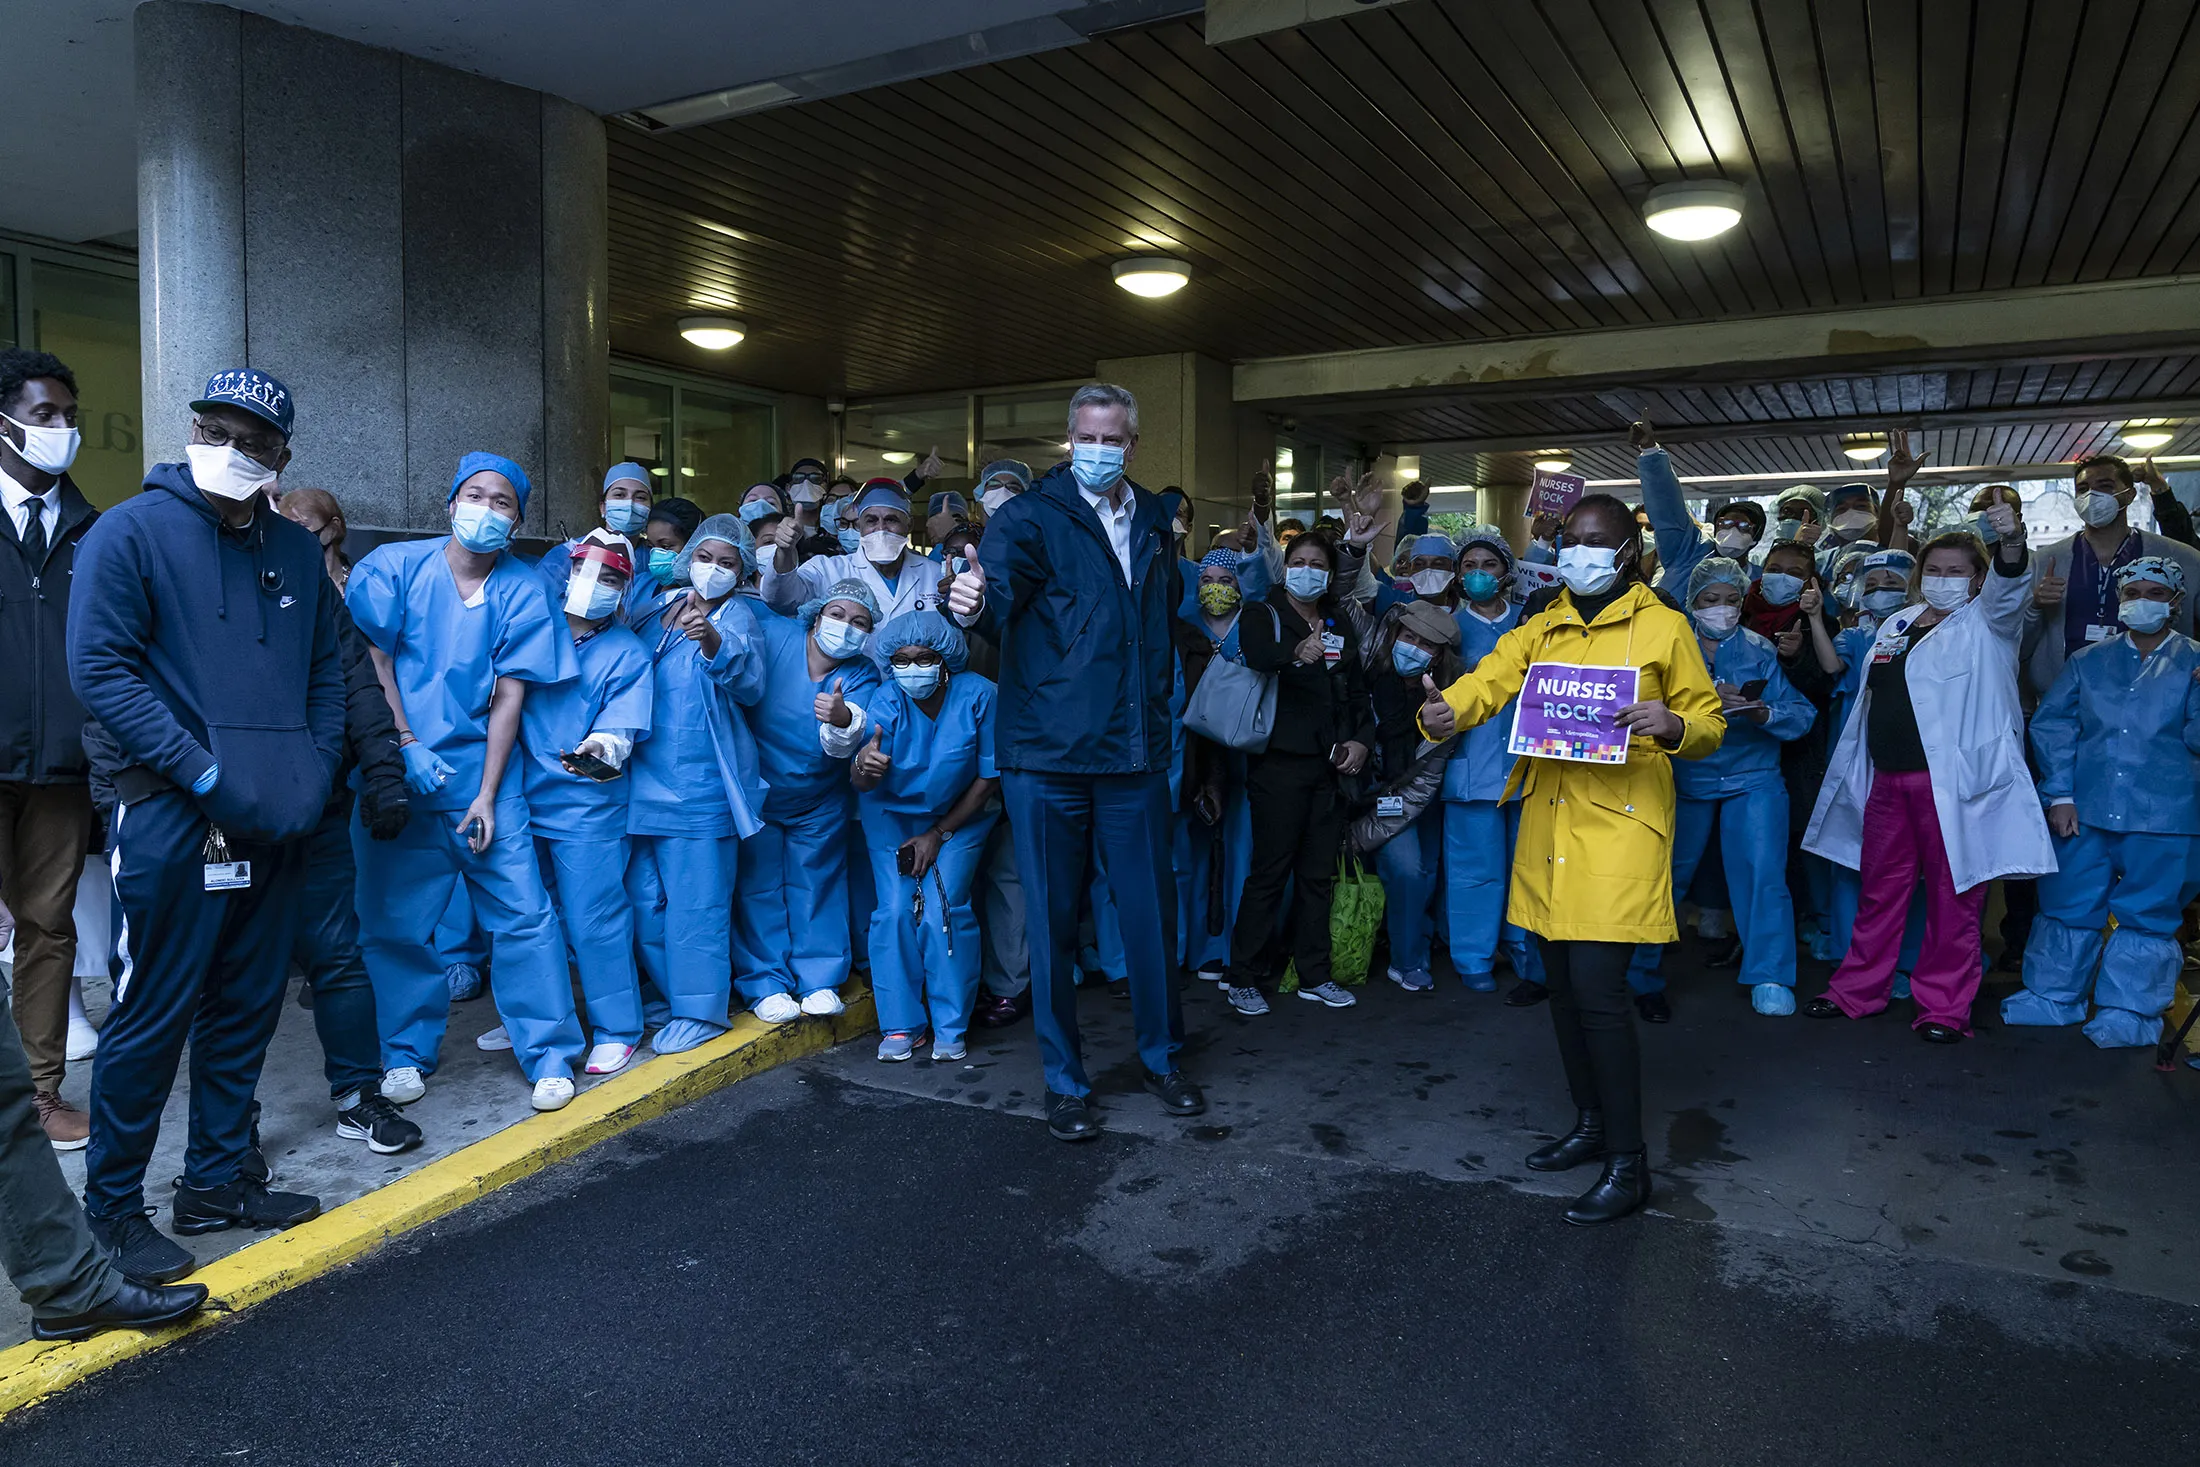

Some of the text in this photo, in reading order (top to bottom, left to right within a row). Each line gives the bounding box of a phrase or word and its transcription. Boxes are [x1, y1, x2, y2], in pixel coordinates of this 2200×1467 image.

[1539, 477, 1575, 493] NURSES
[1538, 490, 1565, 505] ROCK
[1517, 566, 1535, 577] WE
[1537, 678, 1617, 701] NURSES
[1543, 701, 1603, 723] ROCK
